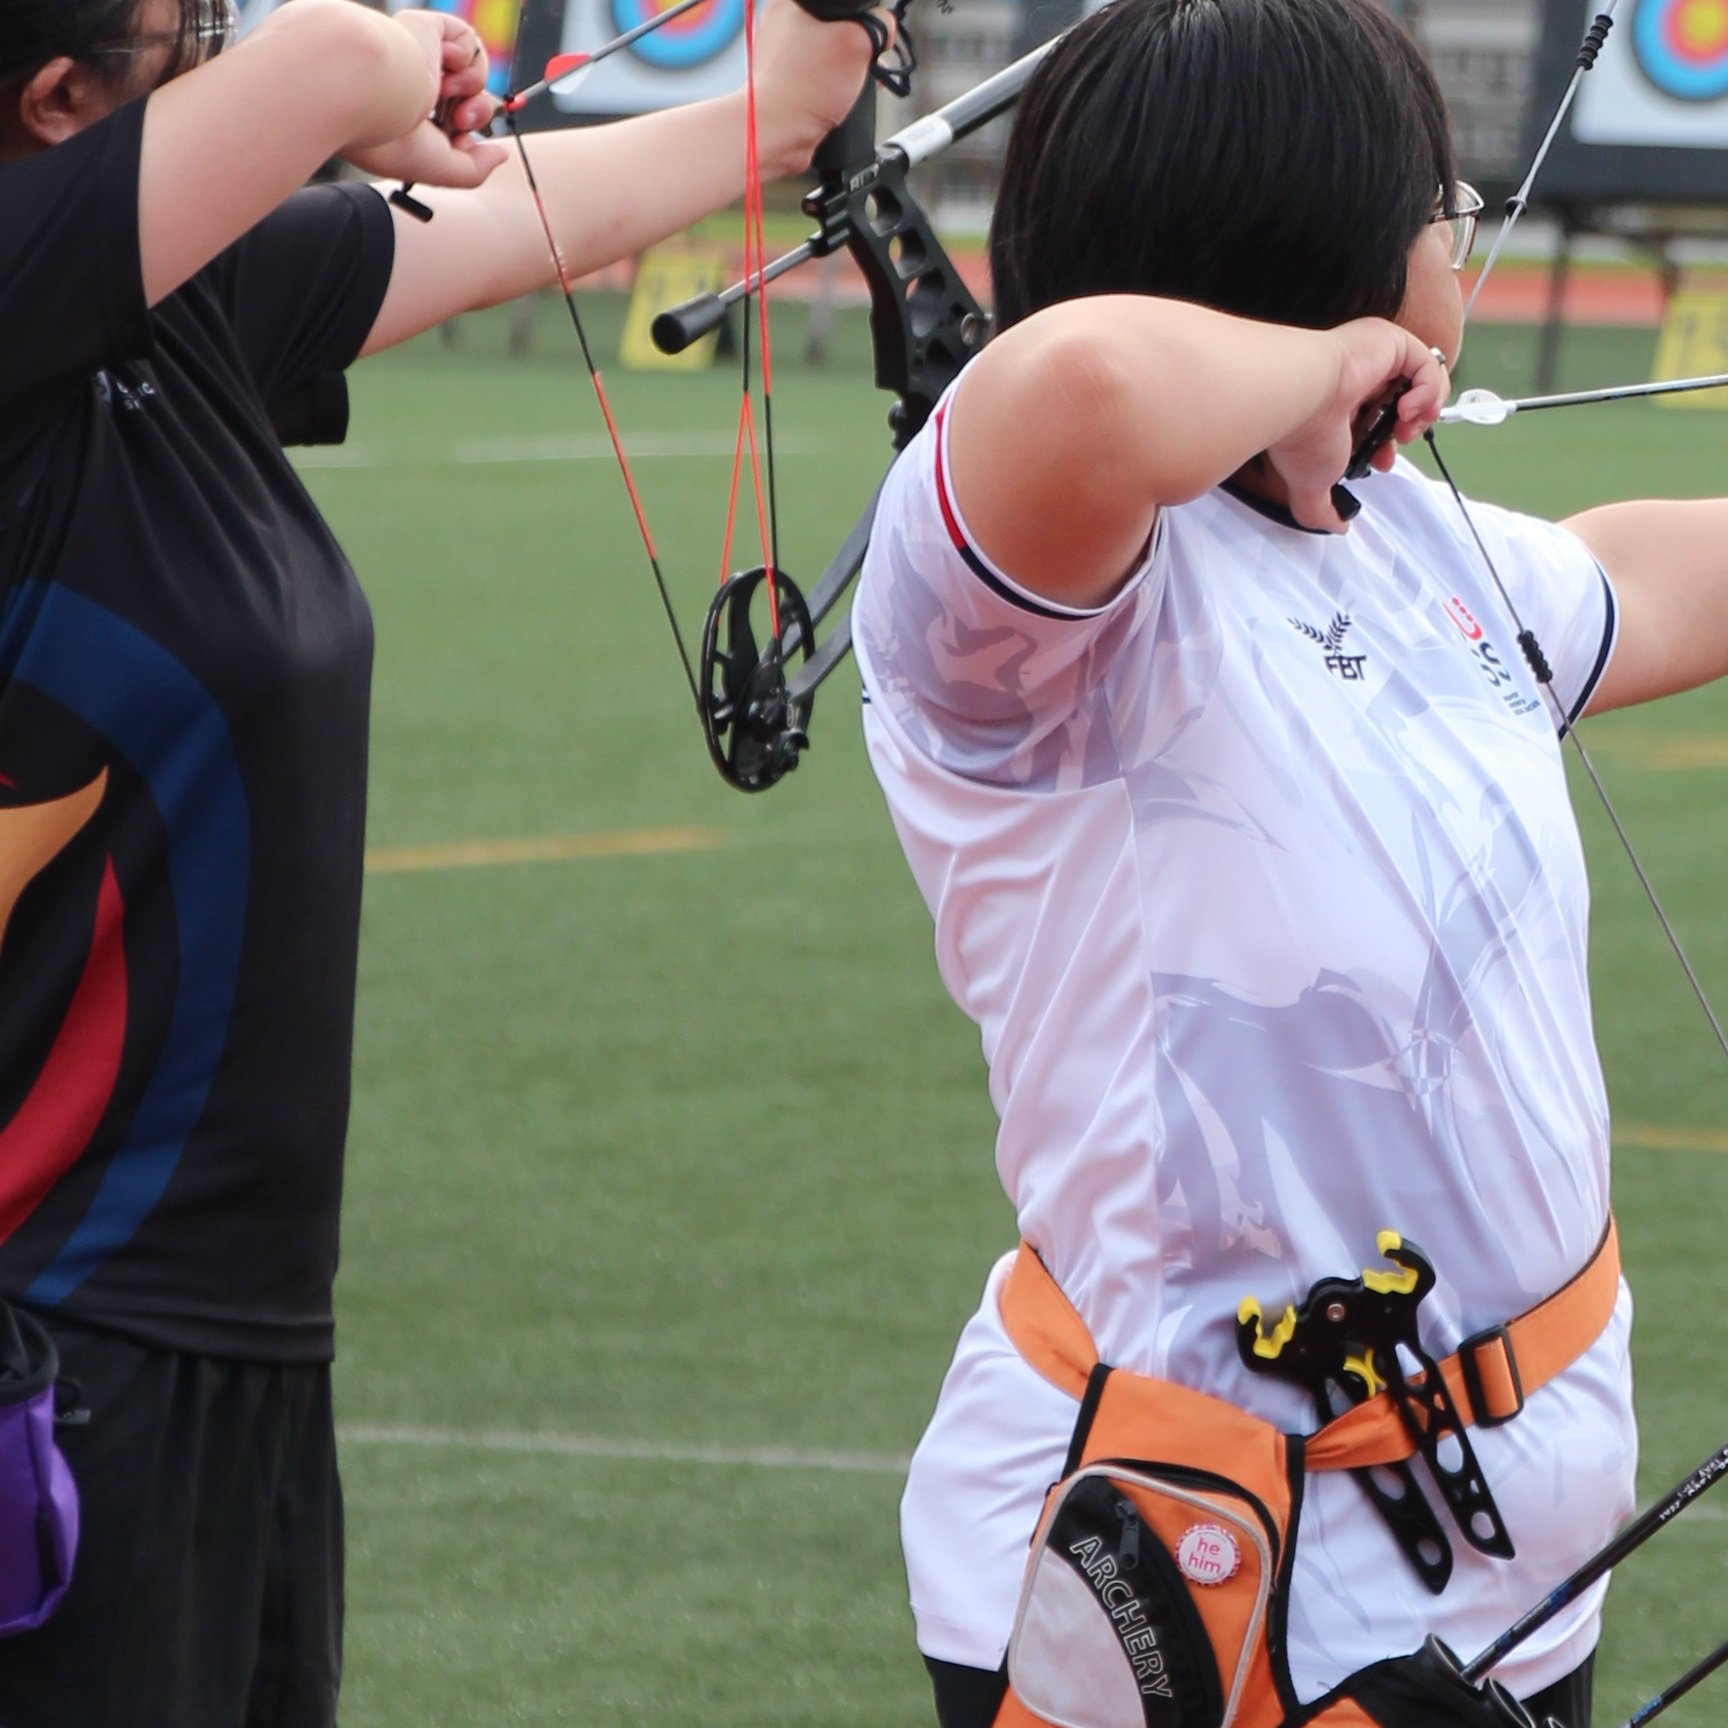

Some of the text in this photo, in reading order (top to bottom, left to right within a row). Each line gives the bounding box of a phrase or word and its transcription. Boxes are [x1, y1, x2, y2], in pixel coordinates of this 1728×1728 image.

[1196, 1536, 1221, 1557] he
[1187, 1552, 1222, 1574] him
[1069, 1535, 1173, 1698] ARCHERY
